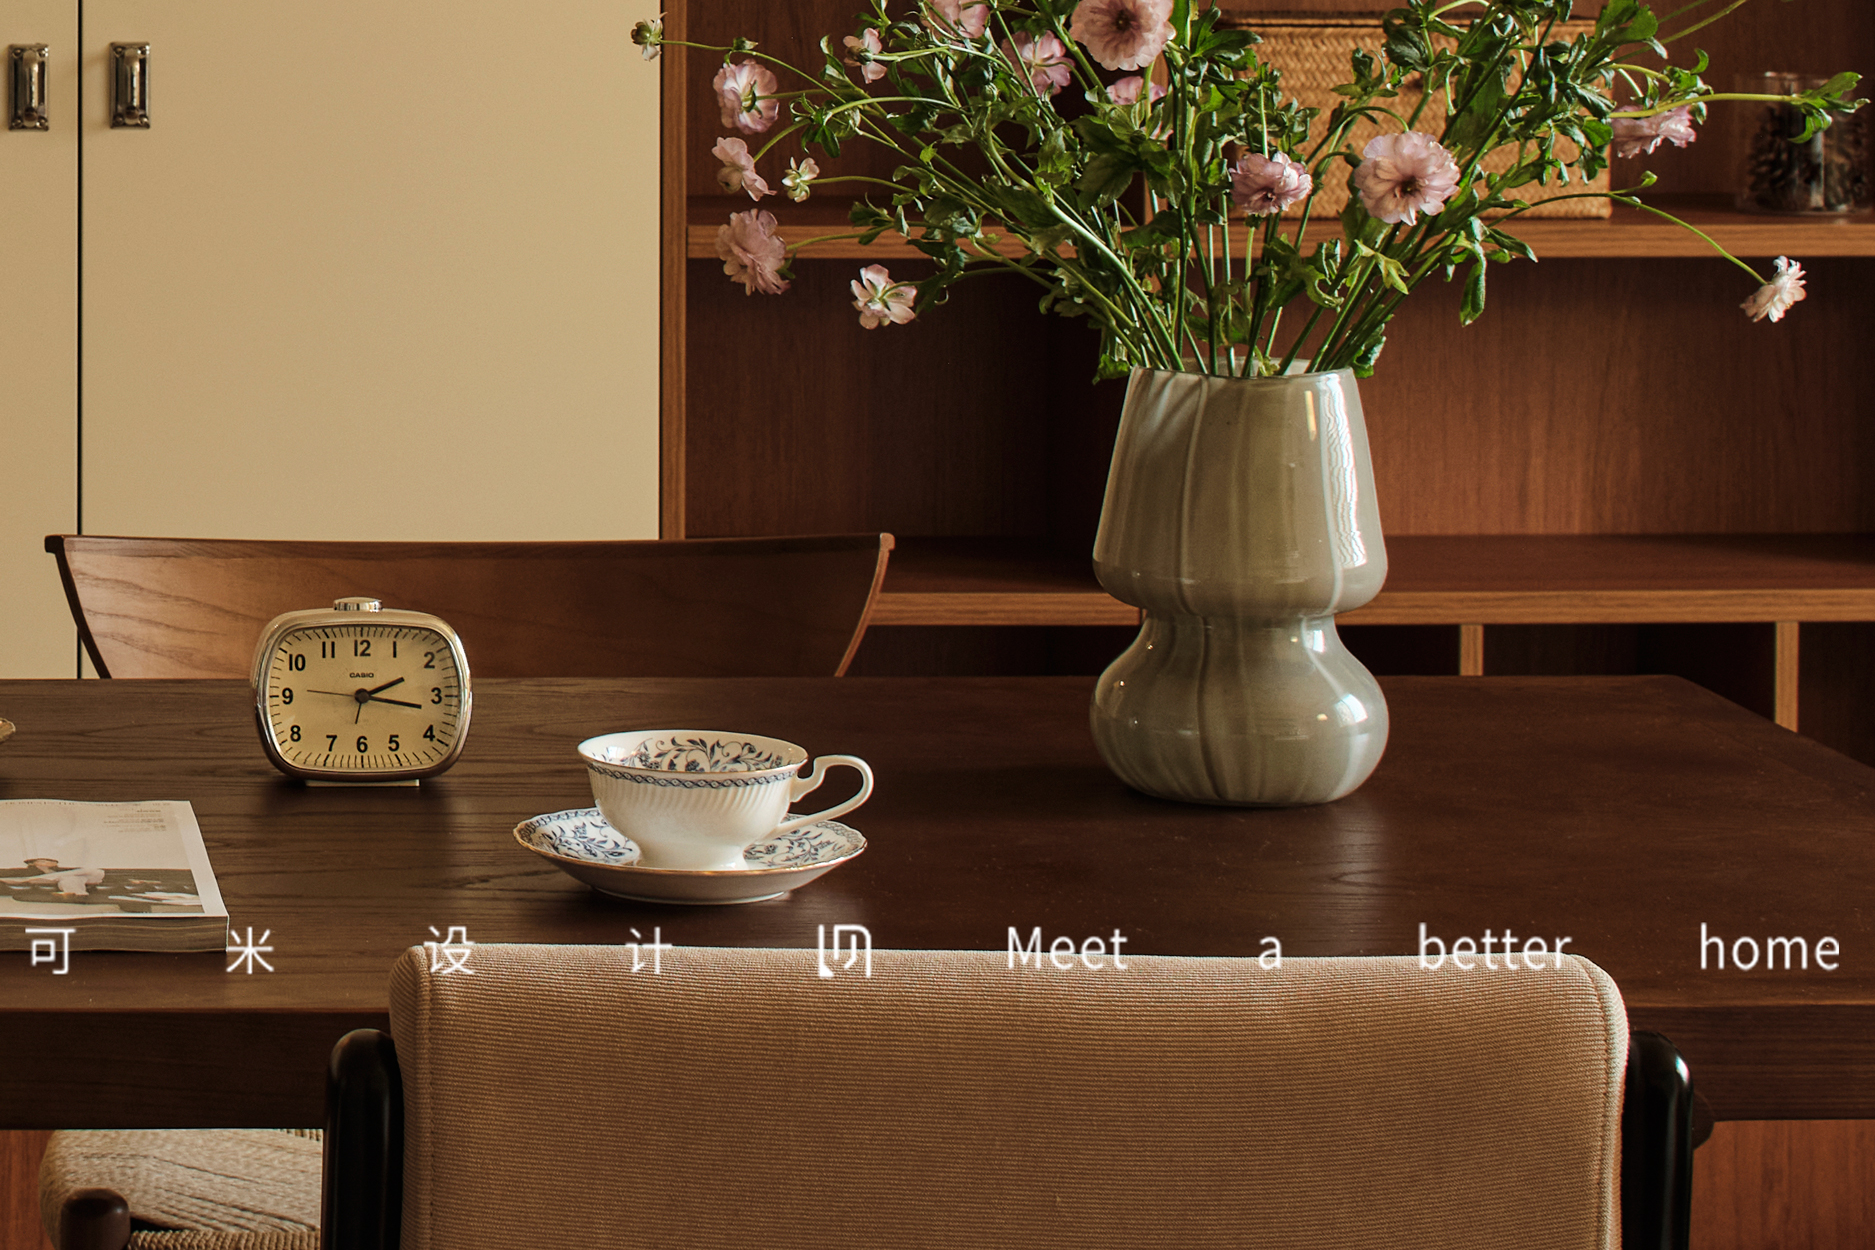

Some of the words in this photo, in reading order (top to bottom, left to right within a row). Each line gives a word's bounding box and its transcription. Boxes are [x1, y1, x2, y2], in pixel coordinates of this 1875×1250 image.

[321, 640, 336, 659] 11
[353, 639, 371, 657] 12
[392, 640, 398, 658] 1
[288, 653, 306, 671] 10
[423, 651, 436, 669] 2
[281, 687, 294, 705] 9
[430, 687, 443, 705] 3
[289, 725, 302, 742] 8
[422, 724, 436, 742] 4
[325, 734, 338, 752] 7
[356, 735, 369, 753] 6
[387, 734, 400, 752] 5
